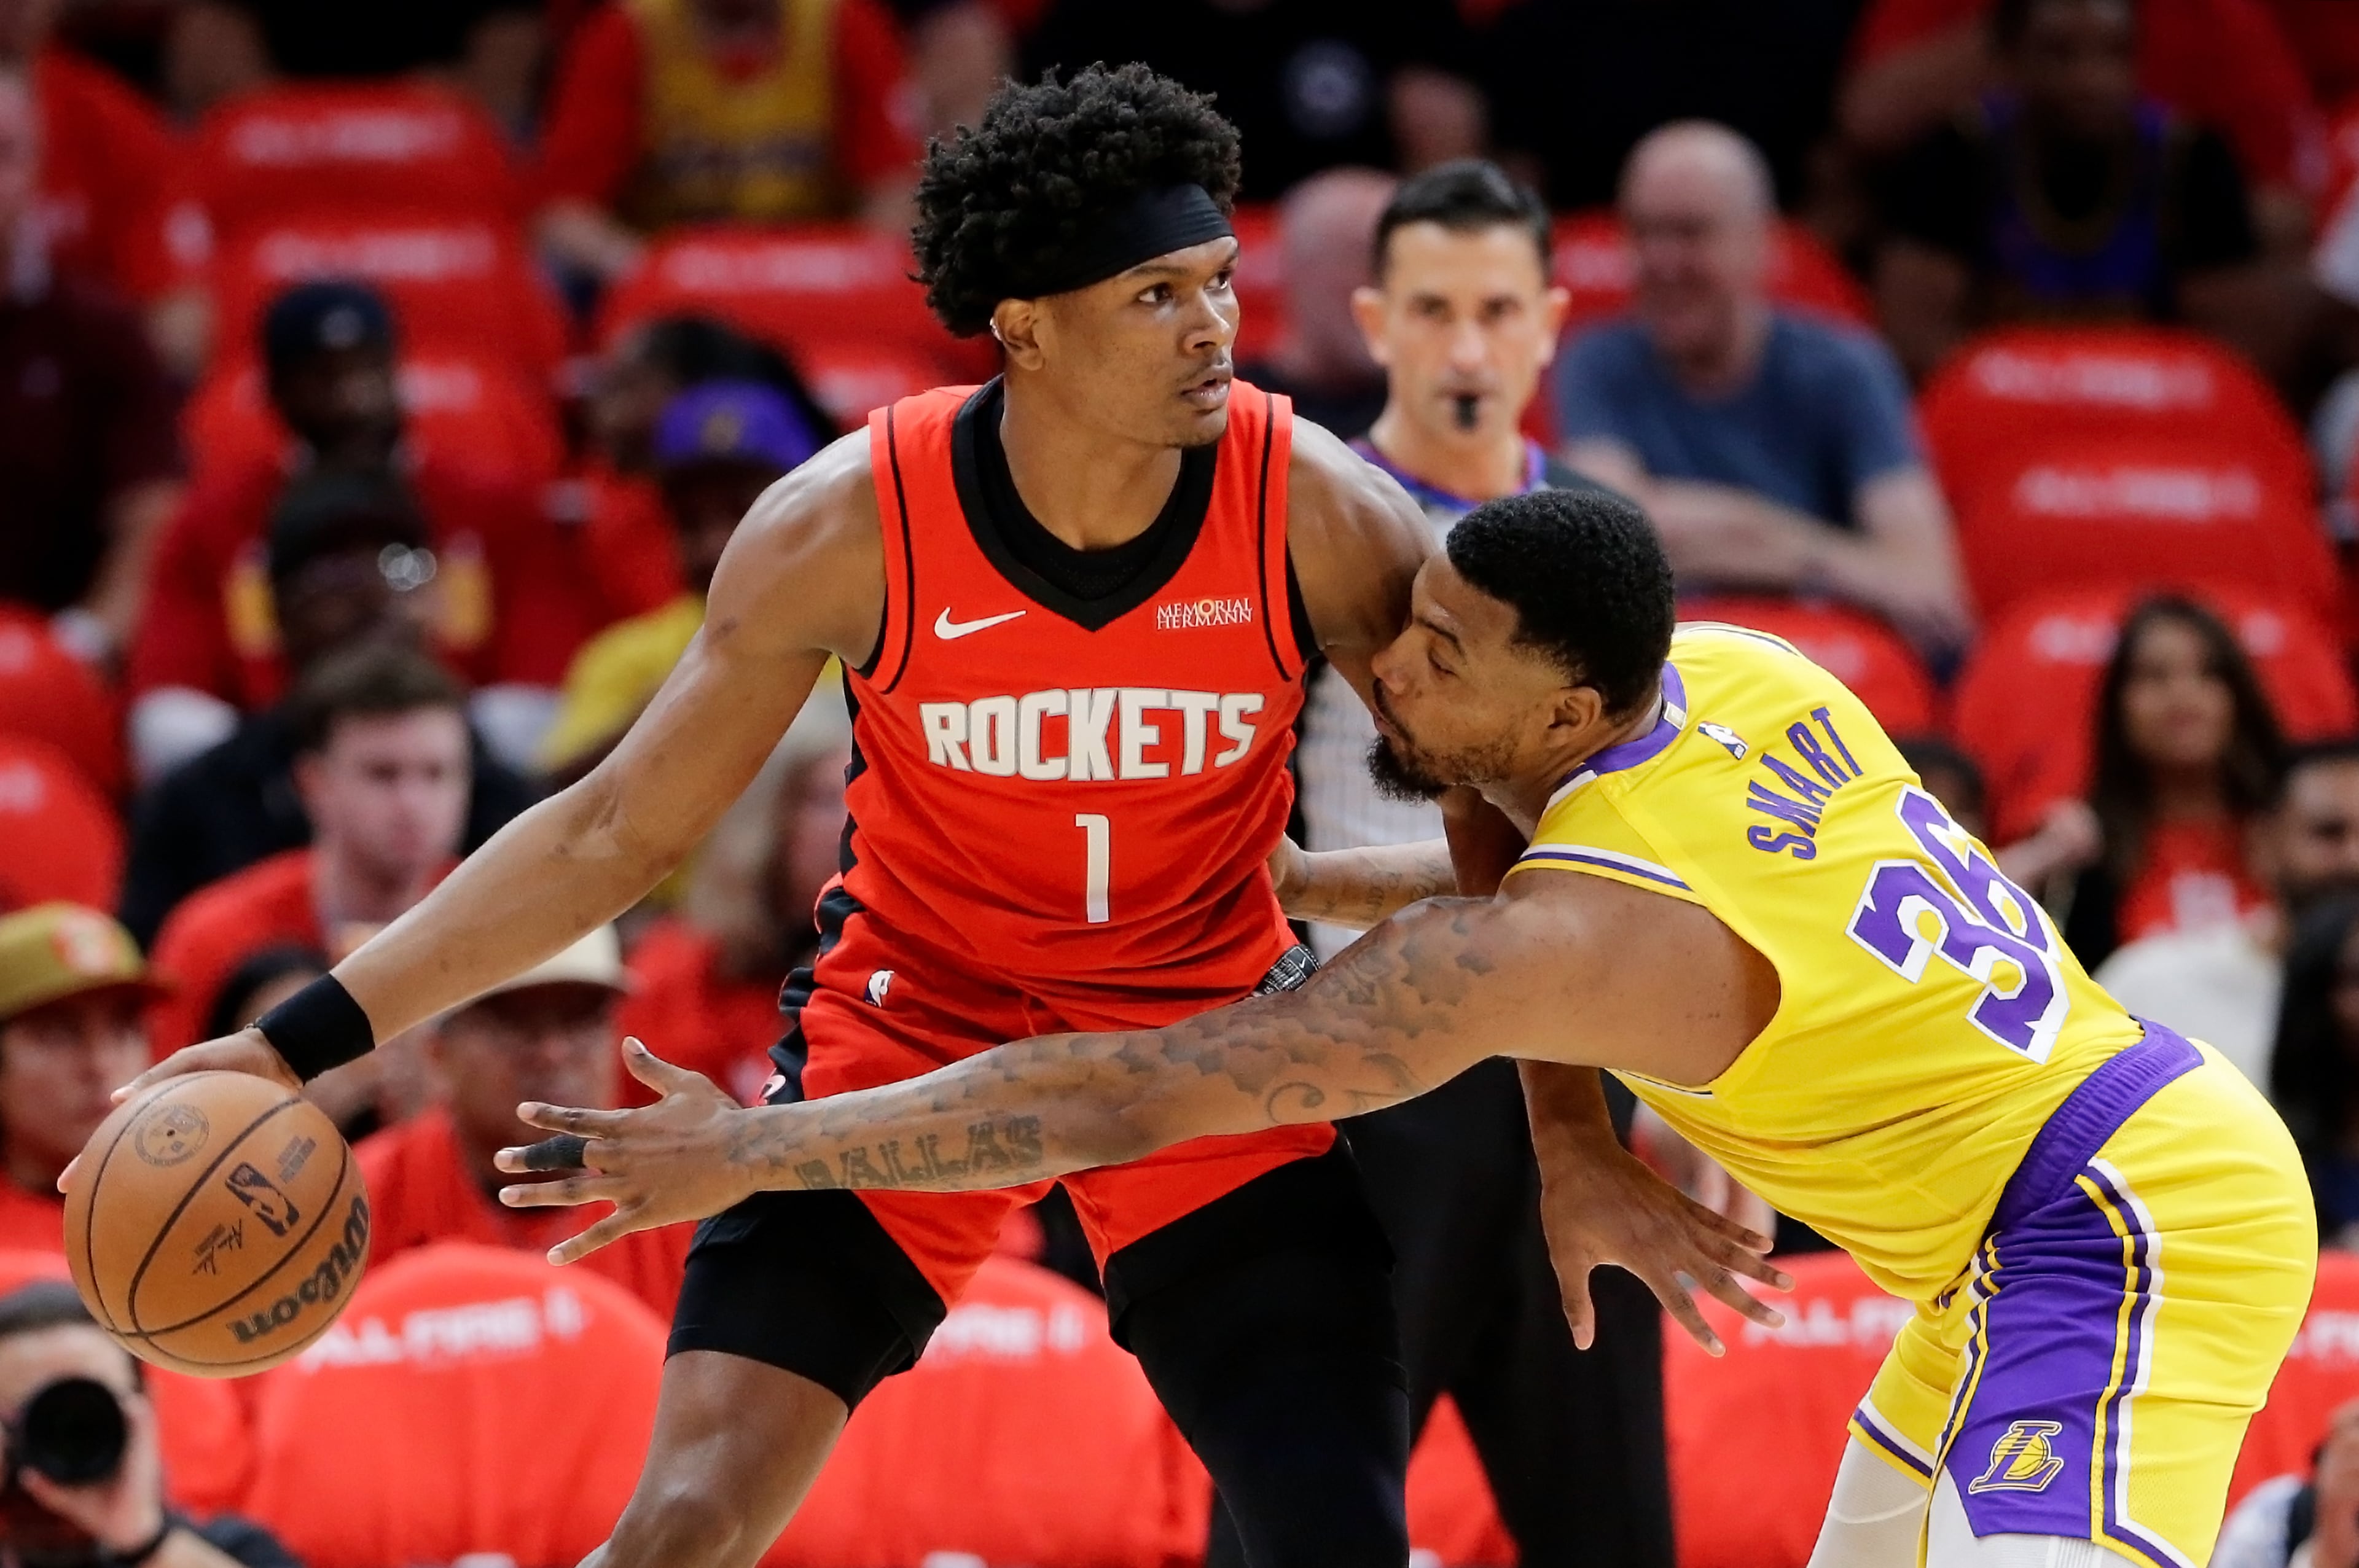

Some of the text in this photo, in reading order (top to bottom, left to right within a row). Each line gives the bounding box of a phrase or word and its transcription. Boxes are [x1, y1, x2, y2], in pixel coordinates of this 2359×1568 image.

[1157, 598, 1253, 618] MEMORIAL
[1157, 609, 1252, 630] HERMANN
[918, 687, 1265, 782] ROCKETS
[1746, 706, 1863, 860] SMART
[1075, 813, 1110, 924] 1
[1845, 783, 2071, 1066] 36
[793, 1115, 1043, 1190] DALLAS
